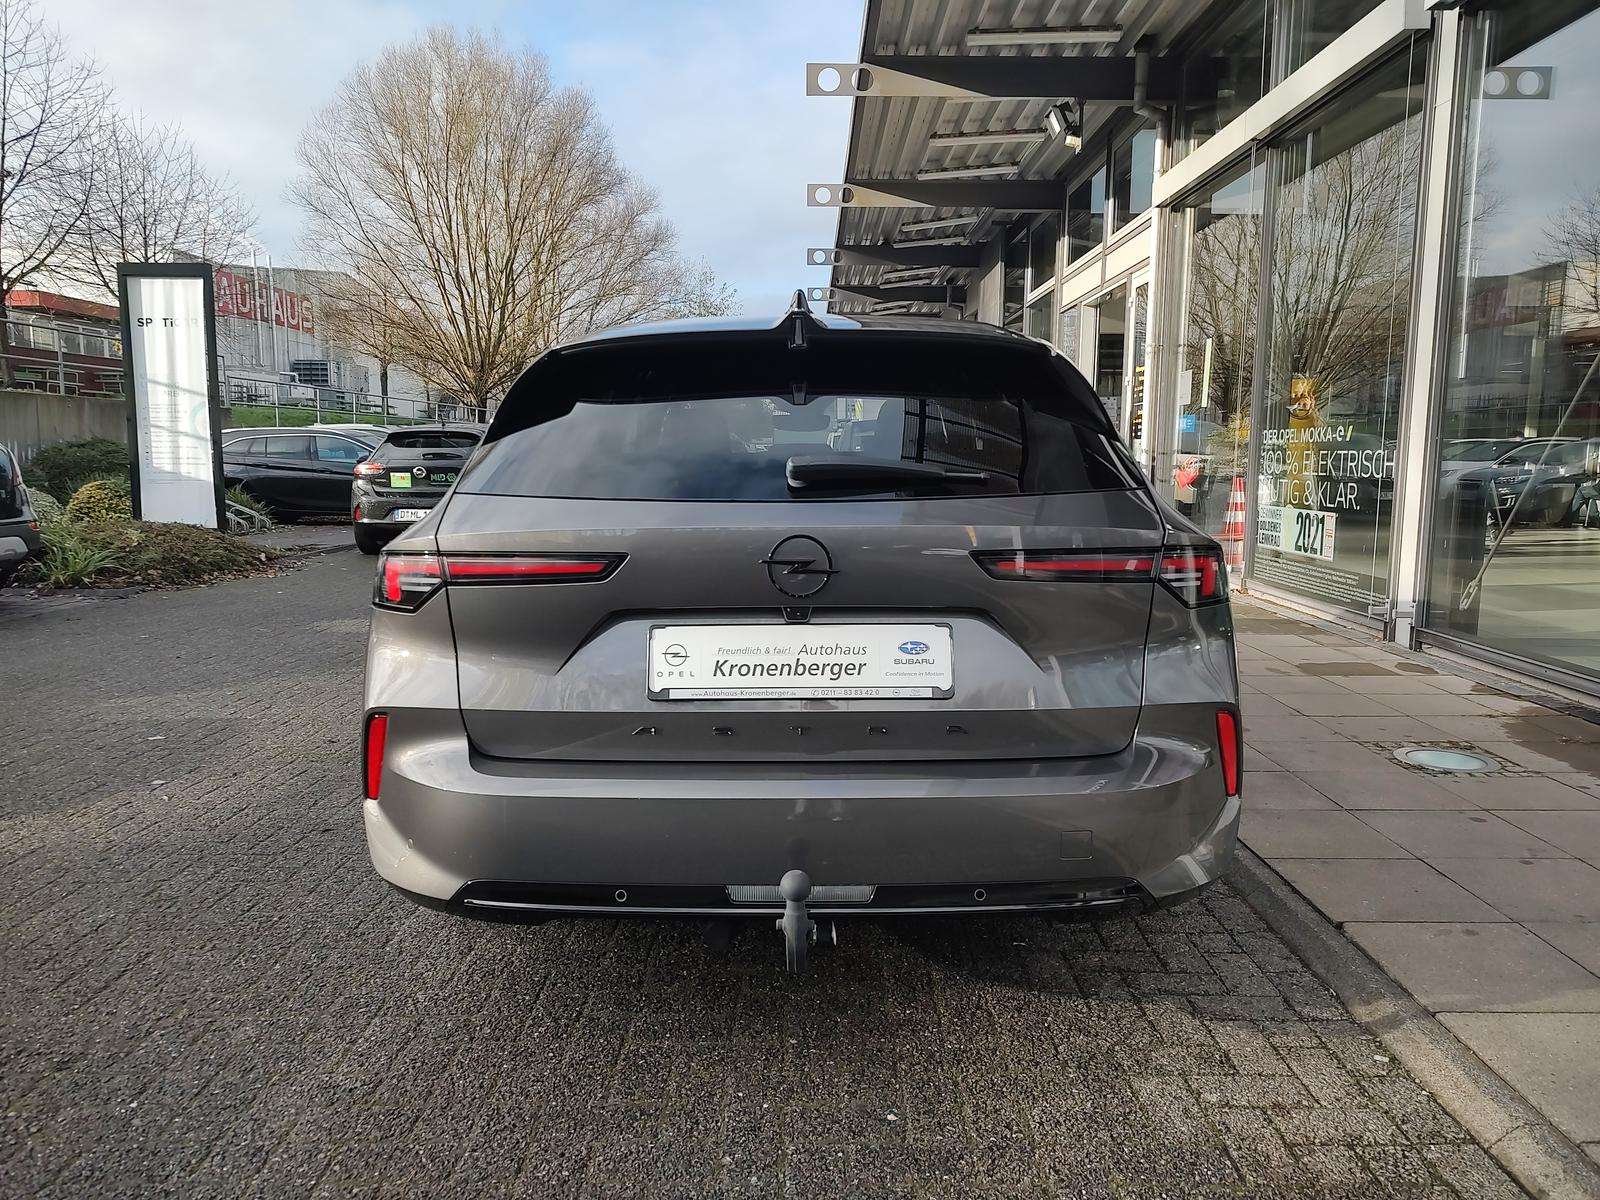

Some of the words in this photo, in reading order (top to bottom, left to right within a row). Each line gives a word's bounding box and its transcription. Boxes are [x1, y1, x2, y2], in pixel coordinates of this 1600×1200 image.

[217, 276, 314, 328] AUHAUS
[1263, 429, 1277, 444] DER
[1279, 428, 1299, 443] OPEL
[1261, 450, 1283, 475] 100
[1285, 450, 1299, 475] %
[1302, 449, 1396, 479] ELEKTRISCH
[1303, 480, 1314, 506] &
[1317, 481, 1360, 510] KLAR.
[1294, 511, 1326, 556] 2021
[717, 646, 762, 655] Freundlich
[764, 647, 770, 655] &
[773, 646, 791, 655] fair!
[797, 643, 868, 656] Autohaus
[712, 658, 867, 681] Kronenberger
[691, 690, 797, 698] www.Autohaus-Kronenberger.de
